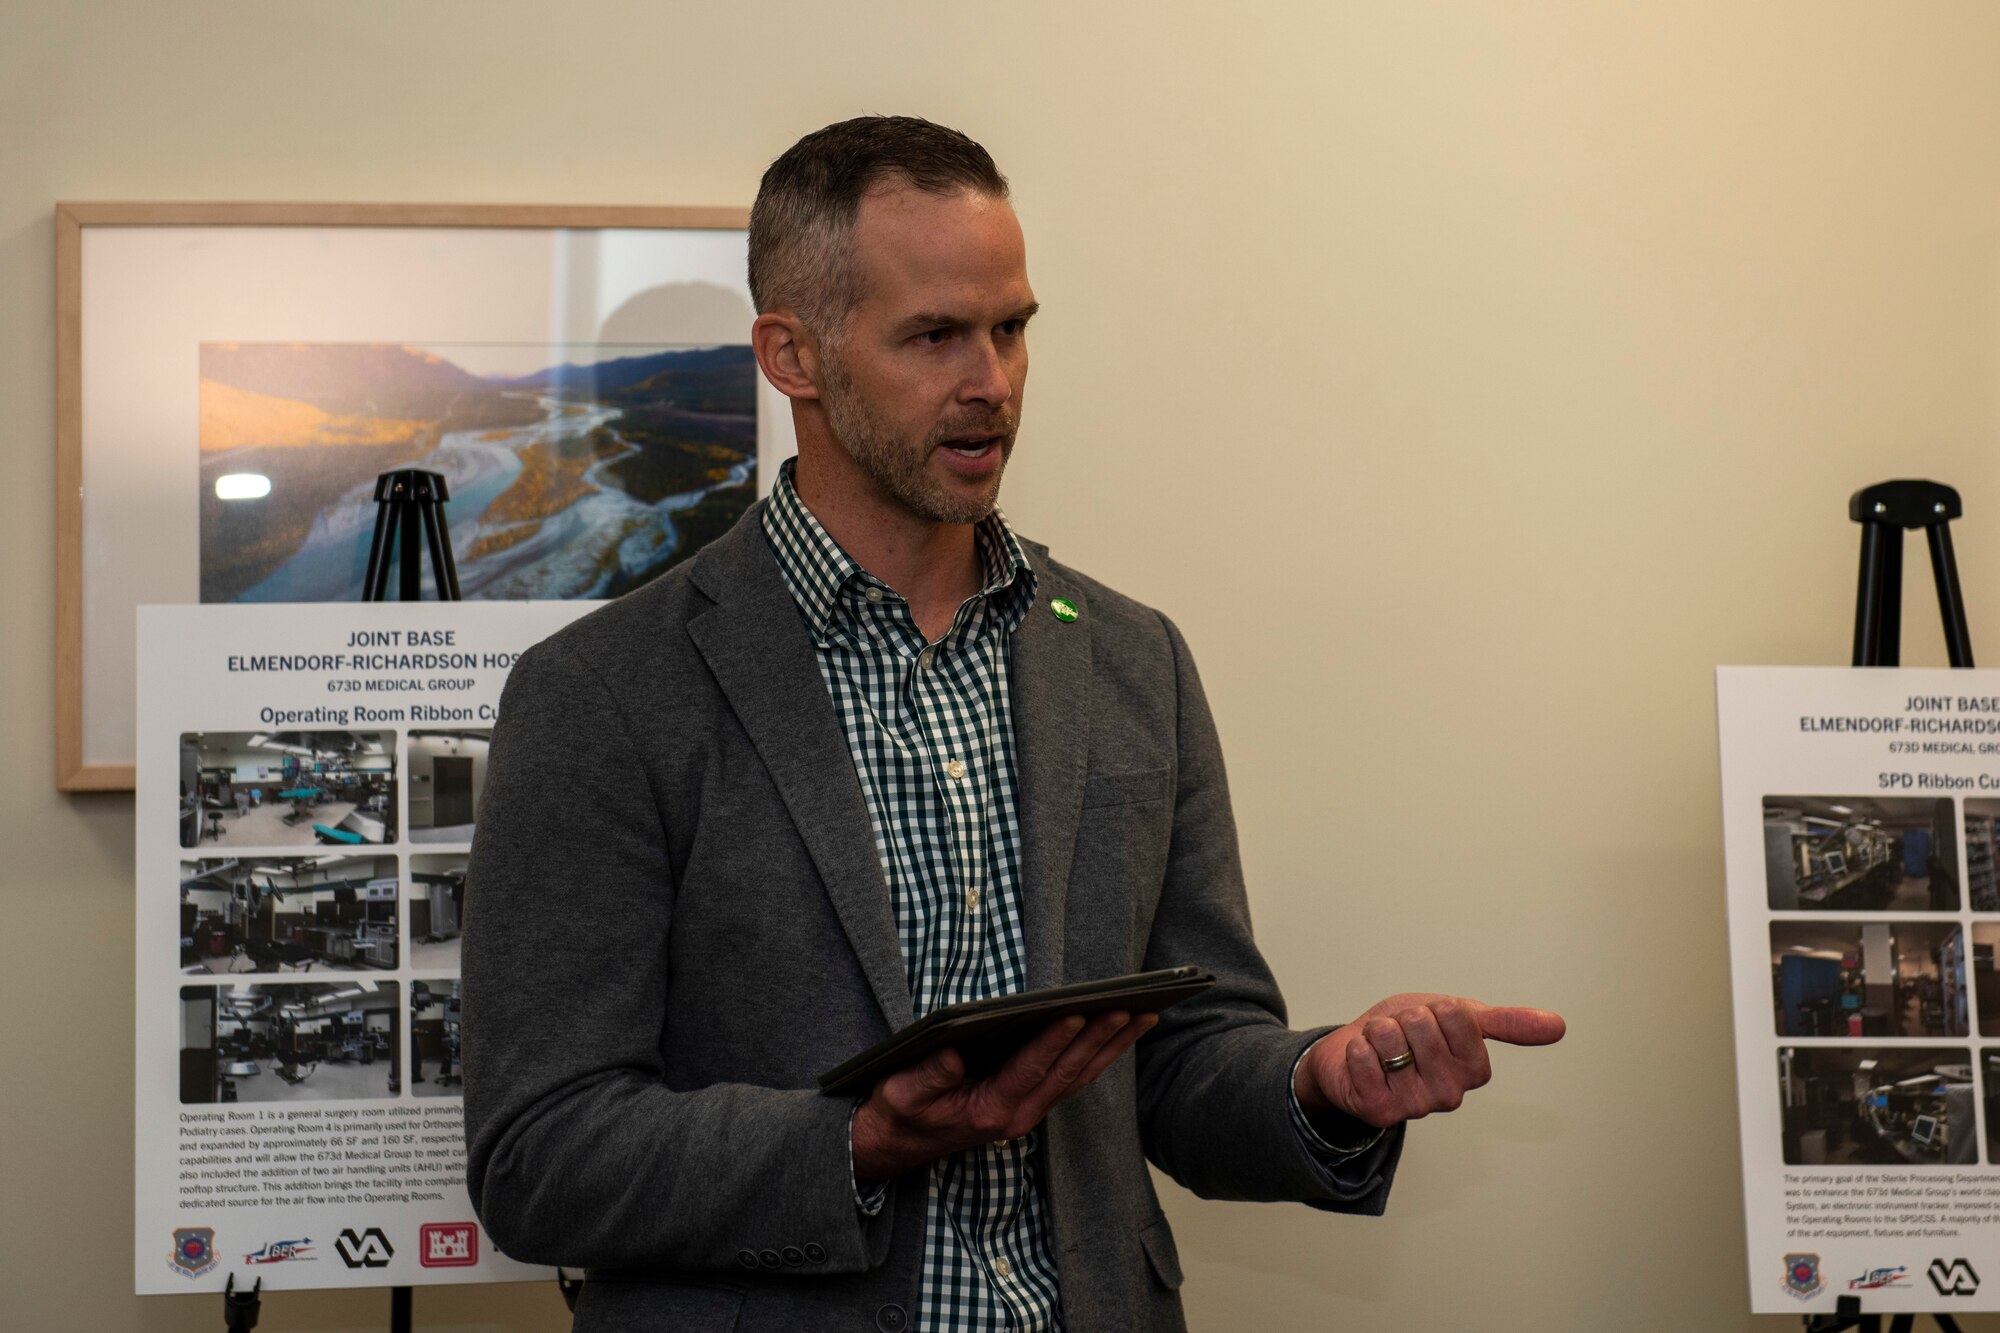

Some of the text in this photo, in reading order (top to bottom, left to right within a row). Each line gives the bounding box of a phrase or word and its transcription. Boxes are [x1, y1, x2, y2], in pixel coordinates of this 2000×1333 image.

[347, 631, 456, 647] JOINT BASE
[228, 652, 521, 672] ELMENDORF-RICHARDSON HOS
[327, 679, 475, 692] 673D MEDICAL GROUP
[1905, 696, 2000, 713] JOINT BASE
[260, 705, 349, 725] Operating
[354, 705, 405, 721] Room
[411, 704, 473, 721] Ribbon
[1889, 741, 1919, 753] 673D
[1922, 742, 1975, 754] MEDICAL
[1879, 772, 2000, 790] SPD Ribbon Cu
[180, 1105, 463, 1123] Operating Room 1 is a general surgery room utilized primarily
[180, 1127, 218, 1137] Podiatry
[220, 1127, 248, 1136] cases.
[250, 1125, 295, 1135] Operating
[297, 1124, 324, 1133] Room
[326, 1123, 332, 1131] 4
[334, 1123, 341, 1131] is
[343, 1122, 382, 1133] primarily
[385, 1121, 407, 1130] used
[409, 1120, 421, 1129] for
[180, 1142, 197, 1151] and
[200, 1141, 245, 1151] expanded
[249, 1140, 260, 1150] by
[262, 1137, 327, 1150] approximately
[346, 1136, 358, 1145] SF
[361, 1136, 379, 1145] and
[382, 1135, 400, 1144] 160
[180, 1156, 232, 1166] capabilities
[234, 1155, 252, 1164] and
[255, 1154, 270, 1163] will
[273, 1153, 297, 1162] allow
[300, 1152, 315, 1161] the
[317, 1151, 342, 1161] 673d
[345, 1150, 380, 1160] Medical
[383, 1149, 411, 1160] Group
[414, 1149, 424, 1158] to
[427, 1149, 449, 1158] meet
[180, 1170, 198, 1180] also
[201, 1169, 241, 1179] included
[243, 1168, 258, 1178] the
[261, 1167, 298, 1177] addition
[301, 1167, 310, 1176] of
[313, 1167, 329, 1176] two
[332, 1165, 344, 1174] air
[346, 1164, 386, 1175] handling
[388, 1163, 411, 1173] units
[414, 1162, 442, 1173] (AHU)
[1784, 1174, 1799, 1183] The
[1802, 1175, 1833, 1184] primary
[1836, 1175, 1852, 1184] goal
[1855, 1174, 1863, 1182] of
[1865, 1175, 1879, 1183] the
[1910, 1174, 1954, 1184] Processing
[180, 1184, 213, 1195] rooftop
[215, 1183, 260, 1194] structure.
[262, 1182, 282, 1192] This
[284, 1181, 322, 1191] addition
[324, 1180, 353, 1191] brings
[355, 1179, 370, 1188] the
[372, 1178, 402, 1189] facility
[405, 1177, 423, 1187] into
[1785, 1188, 1801, 1196] was
[1803, 1188, 1811, 1196] to
[1813, 1188, 1848, 1196] enhance
[1851, 1187, 1864, 1196] the
[1891, 1187, 1922, 1196] Medical
[179, 1191, 445, 1209] dedicated source for the air flow into the Operating Rooms.
[1787, 1215, 1799, 1224] the
[1801, 1215, 1842, 1225] Operating
[1844, 1215, 1872, 1223] Rooms
[1884, 1215, 1897, 1223] the
[1787, 1229, 1795, 1238] of
[1797, 1229, 1811, 1238] the
[1906, 1229, 1921, 1237] and
[334, 1227, 395, 1268] VA
[1926, 1258, 1981, 1296] VA
